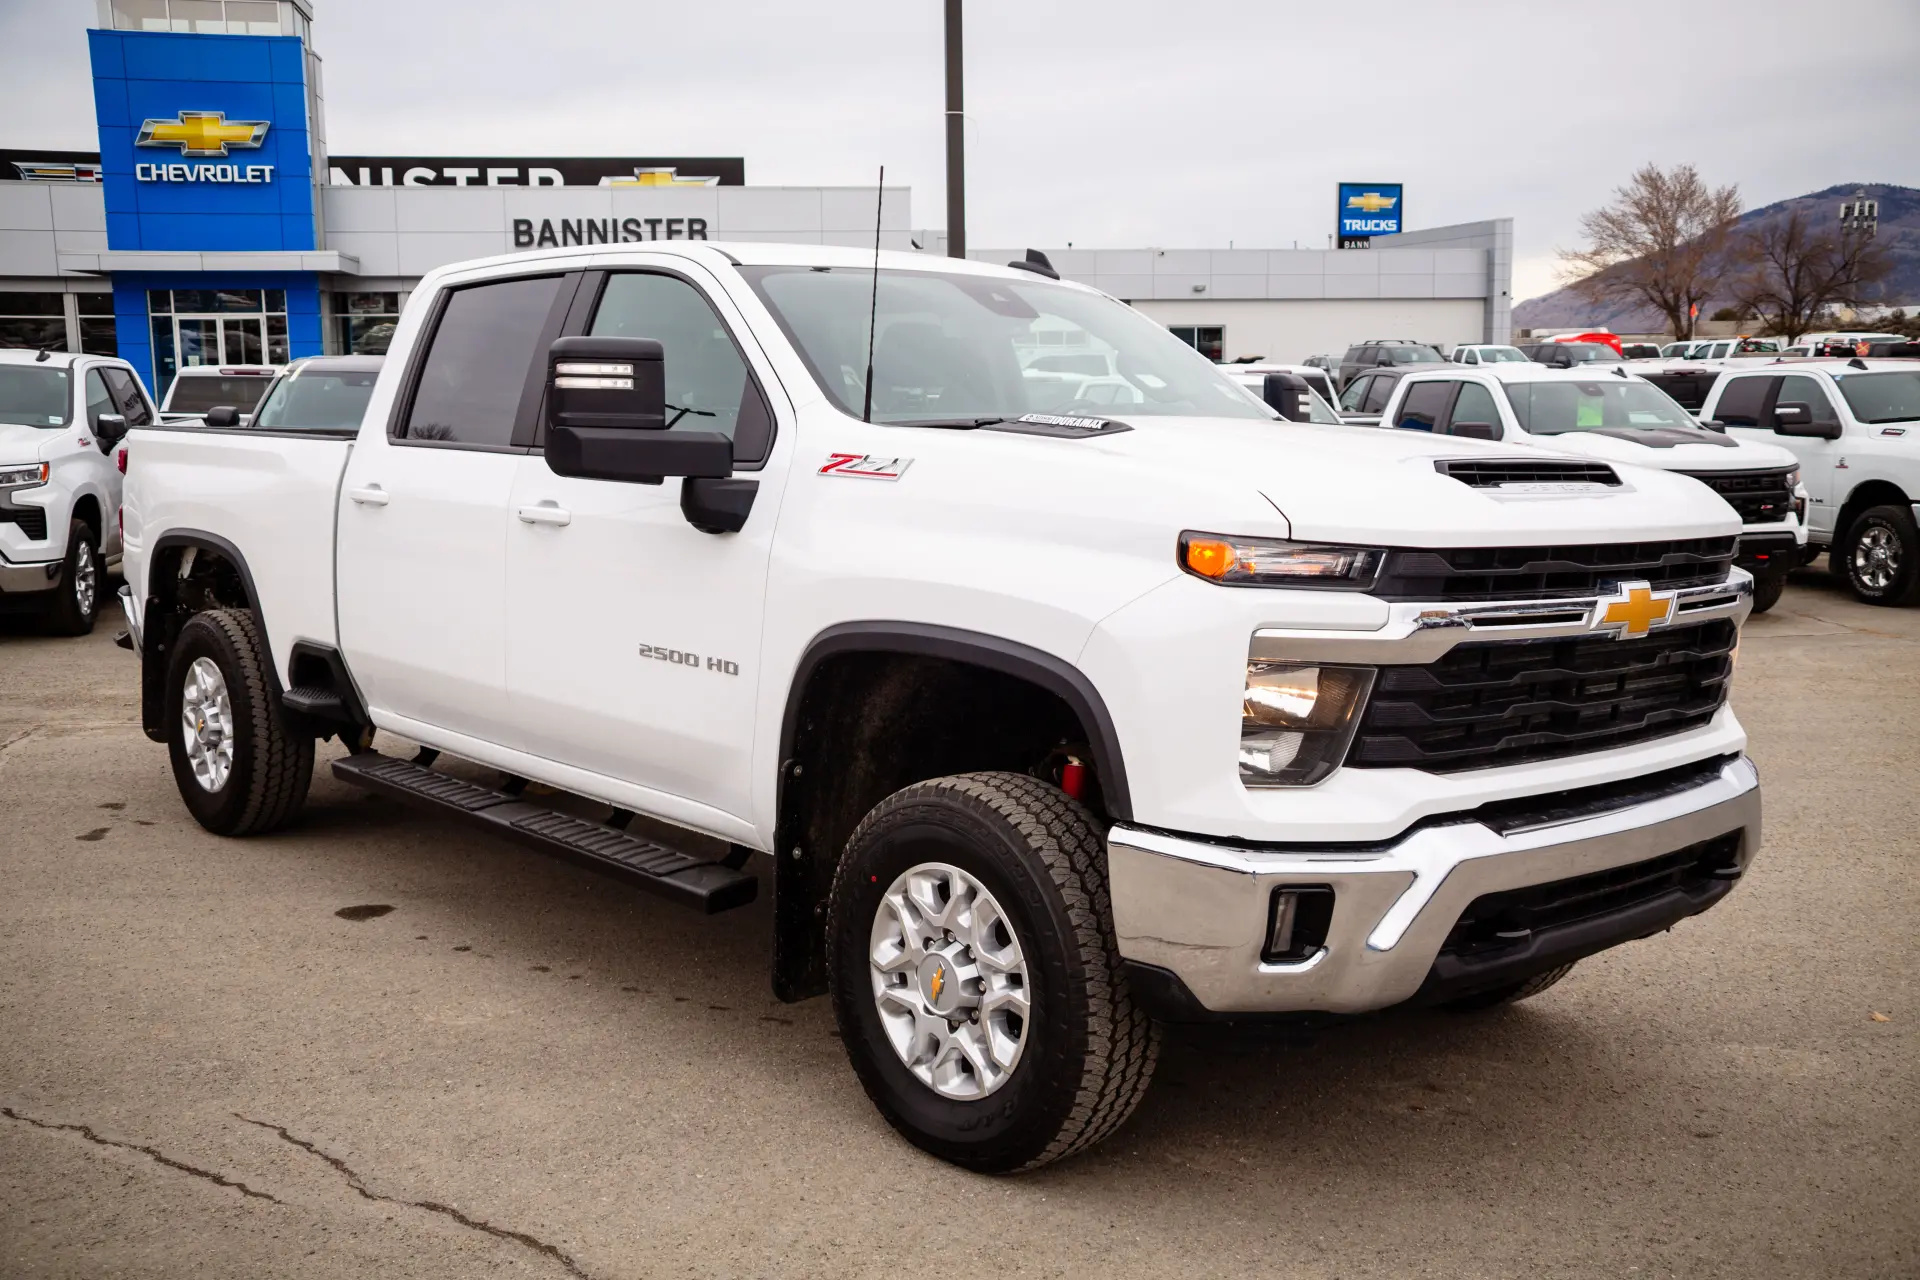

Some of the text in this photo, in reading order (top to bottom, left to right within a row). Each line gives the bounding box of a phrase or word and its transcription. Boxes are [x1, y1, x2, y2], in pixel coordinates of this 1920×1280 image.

[135, 163, 275, 183] CHEVROLET
[513, 217, 708, 248] BANNISTER
[1343, 219, 1397, 231] TRUCKS
[1052, 416, 1107, 429] DURAMAX
[818, 453, 914, 482] Z71
[638, 642, 739, 676] 2500 HD
